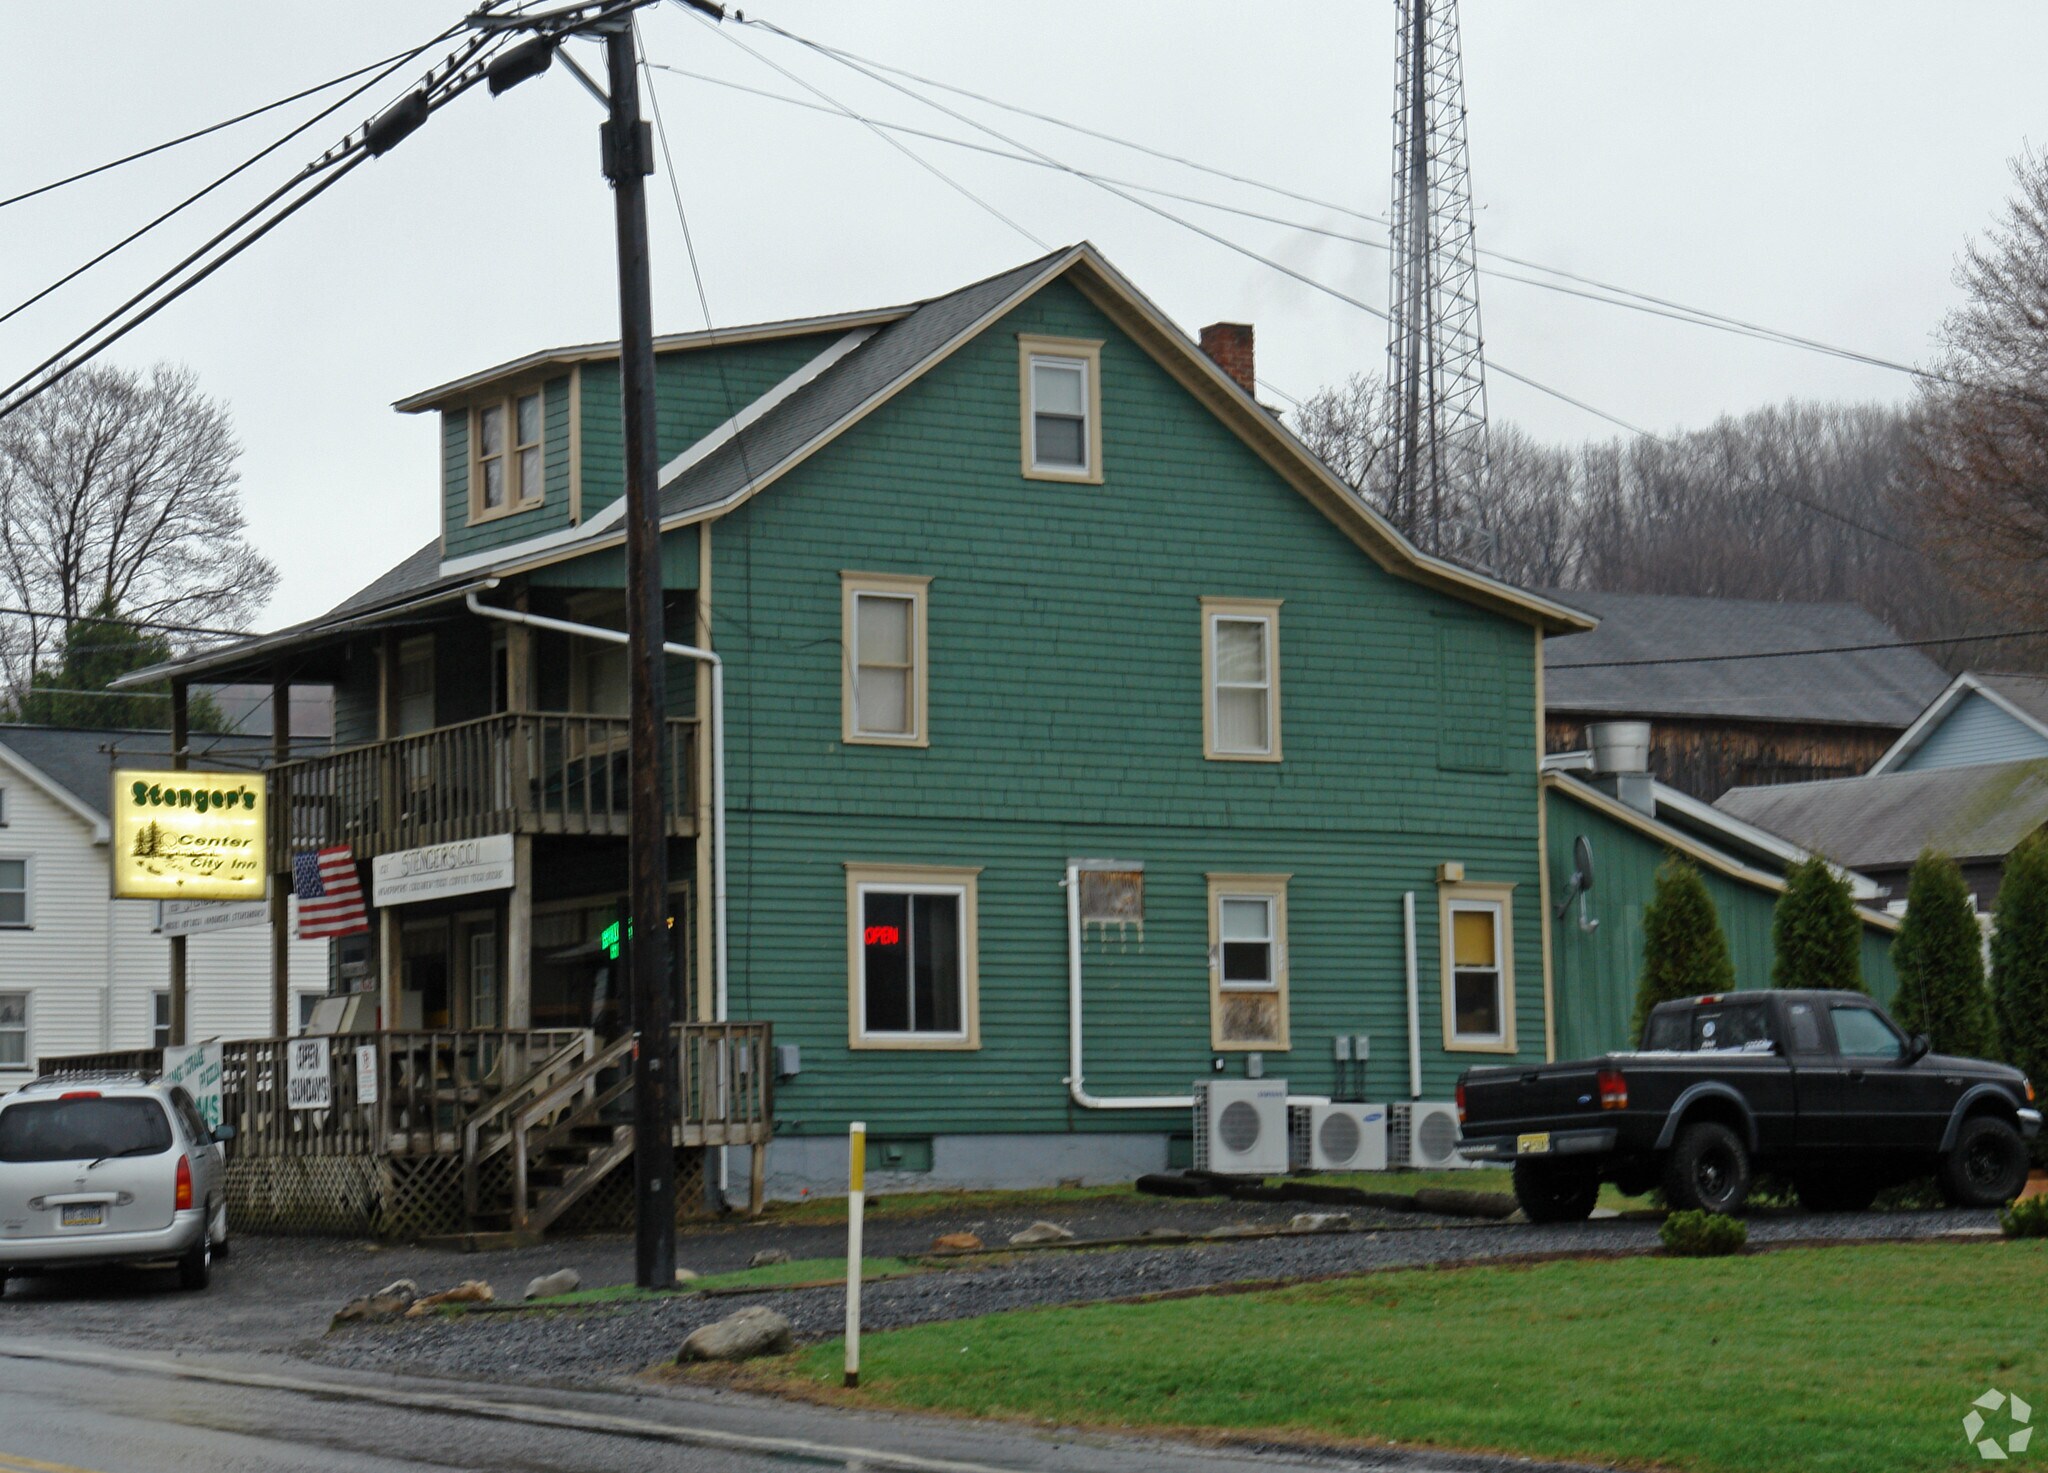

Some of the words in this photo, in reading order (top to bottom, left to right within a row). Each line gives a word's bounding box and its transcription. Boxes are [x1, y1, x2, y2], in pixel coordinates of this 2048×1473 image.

[131, 780, 258, 813] Stenger's
[178, 834, 253, 847] Center
[190, 858, 224, 870] City
[231, 858, 257, 869] Inn
